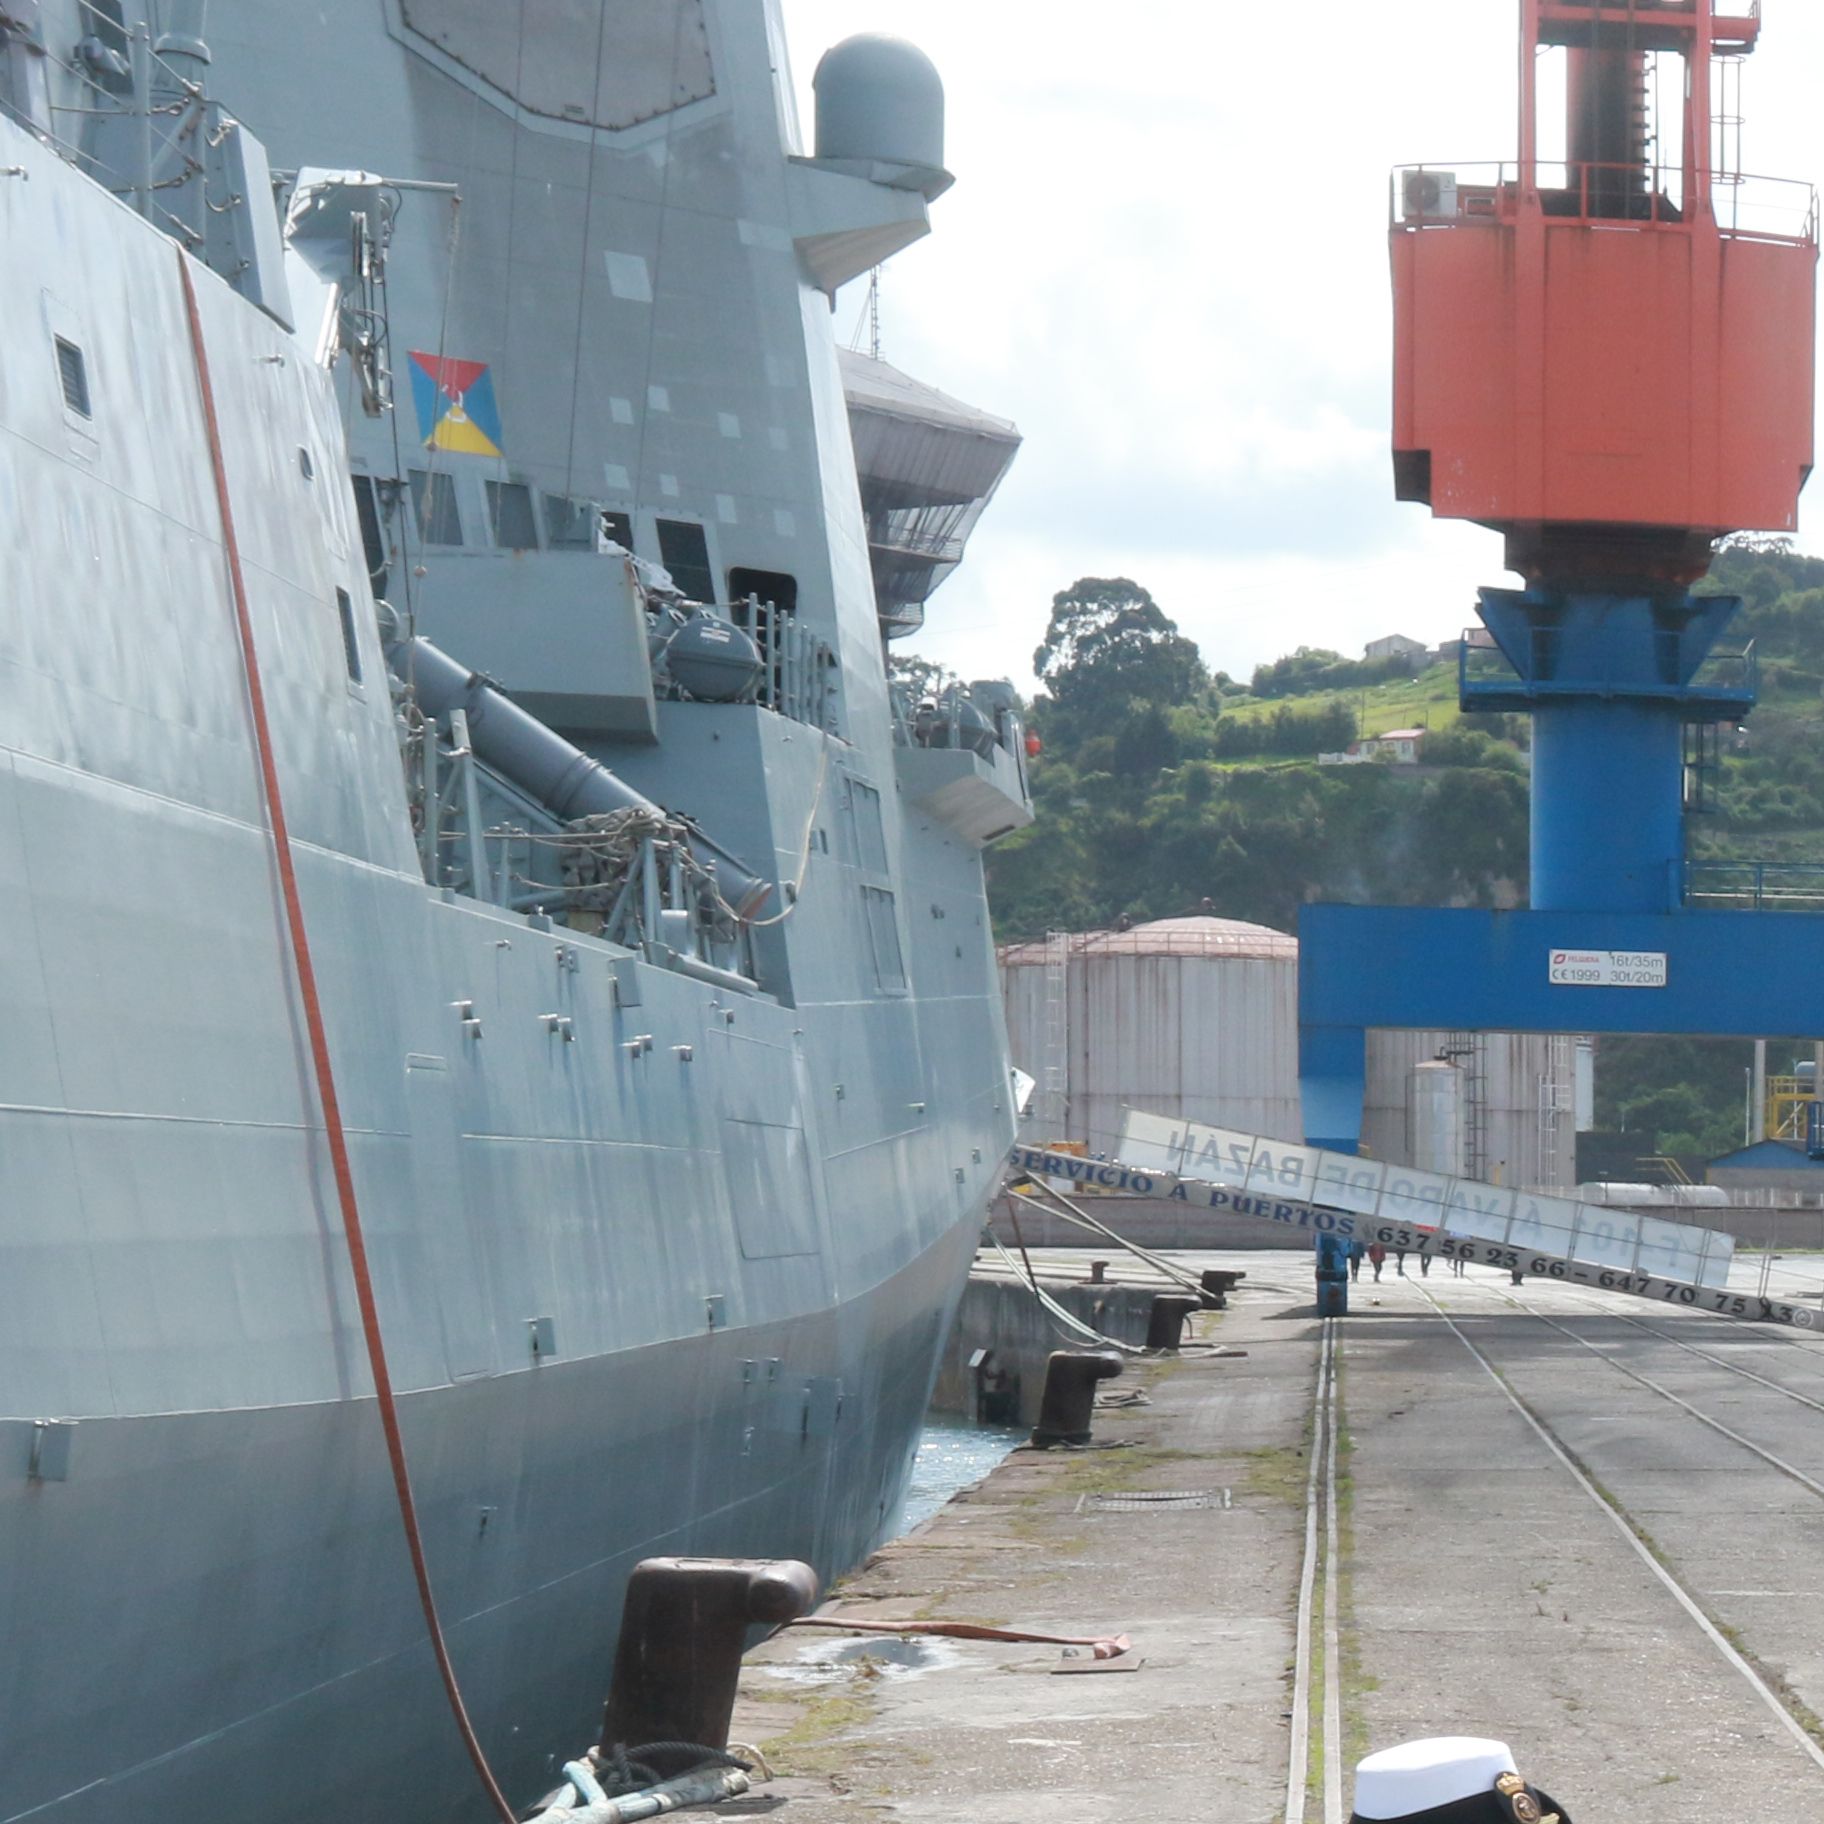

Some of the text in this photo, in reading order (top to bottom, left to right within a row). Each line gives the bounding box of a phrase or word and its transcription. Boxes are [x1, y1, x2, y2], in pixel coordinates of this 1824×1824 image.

[1610, 954, 1664, 968] 16t/35m
[1571, 969, 1600, 981] 1999
[1610, 970, 1664, 983] 30t/20m
[1009, 1147, 1153, 1194] SERVICIO
[1168, 1183, 1188, 1201] A
[1209, 1190, 1355, 1235] PUERTOS
[1376, 1226, 1430, 1250] 637
[1441, 1239, 1476, 1259] 56
[1487, 1248, 1519, 1268] 23
[1530, 1257, 1566, 1277] 66
[1599, 1271, 1650, 1293] 647
[1664, 1283, 1696, 1304] 70
[1715, 1294, 1746, 1314] 75
